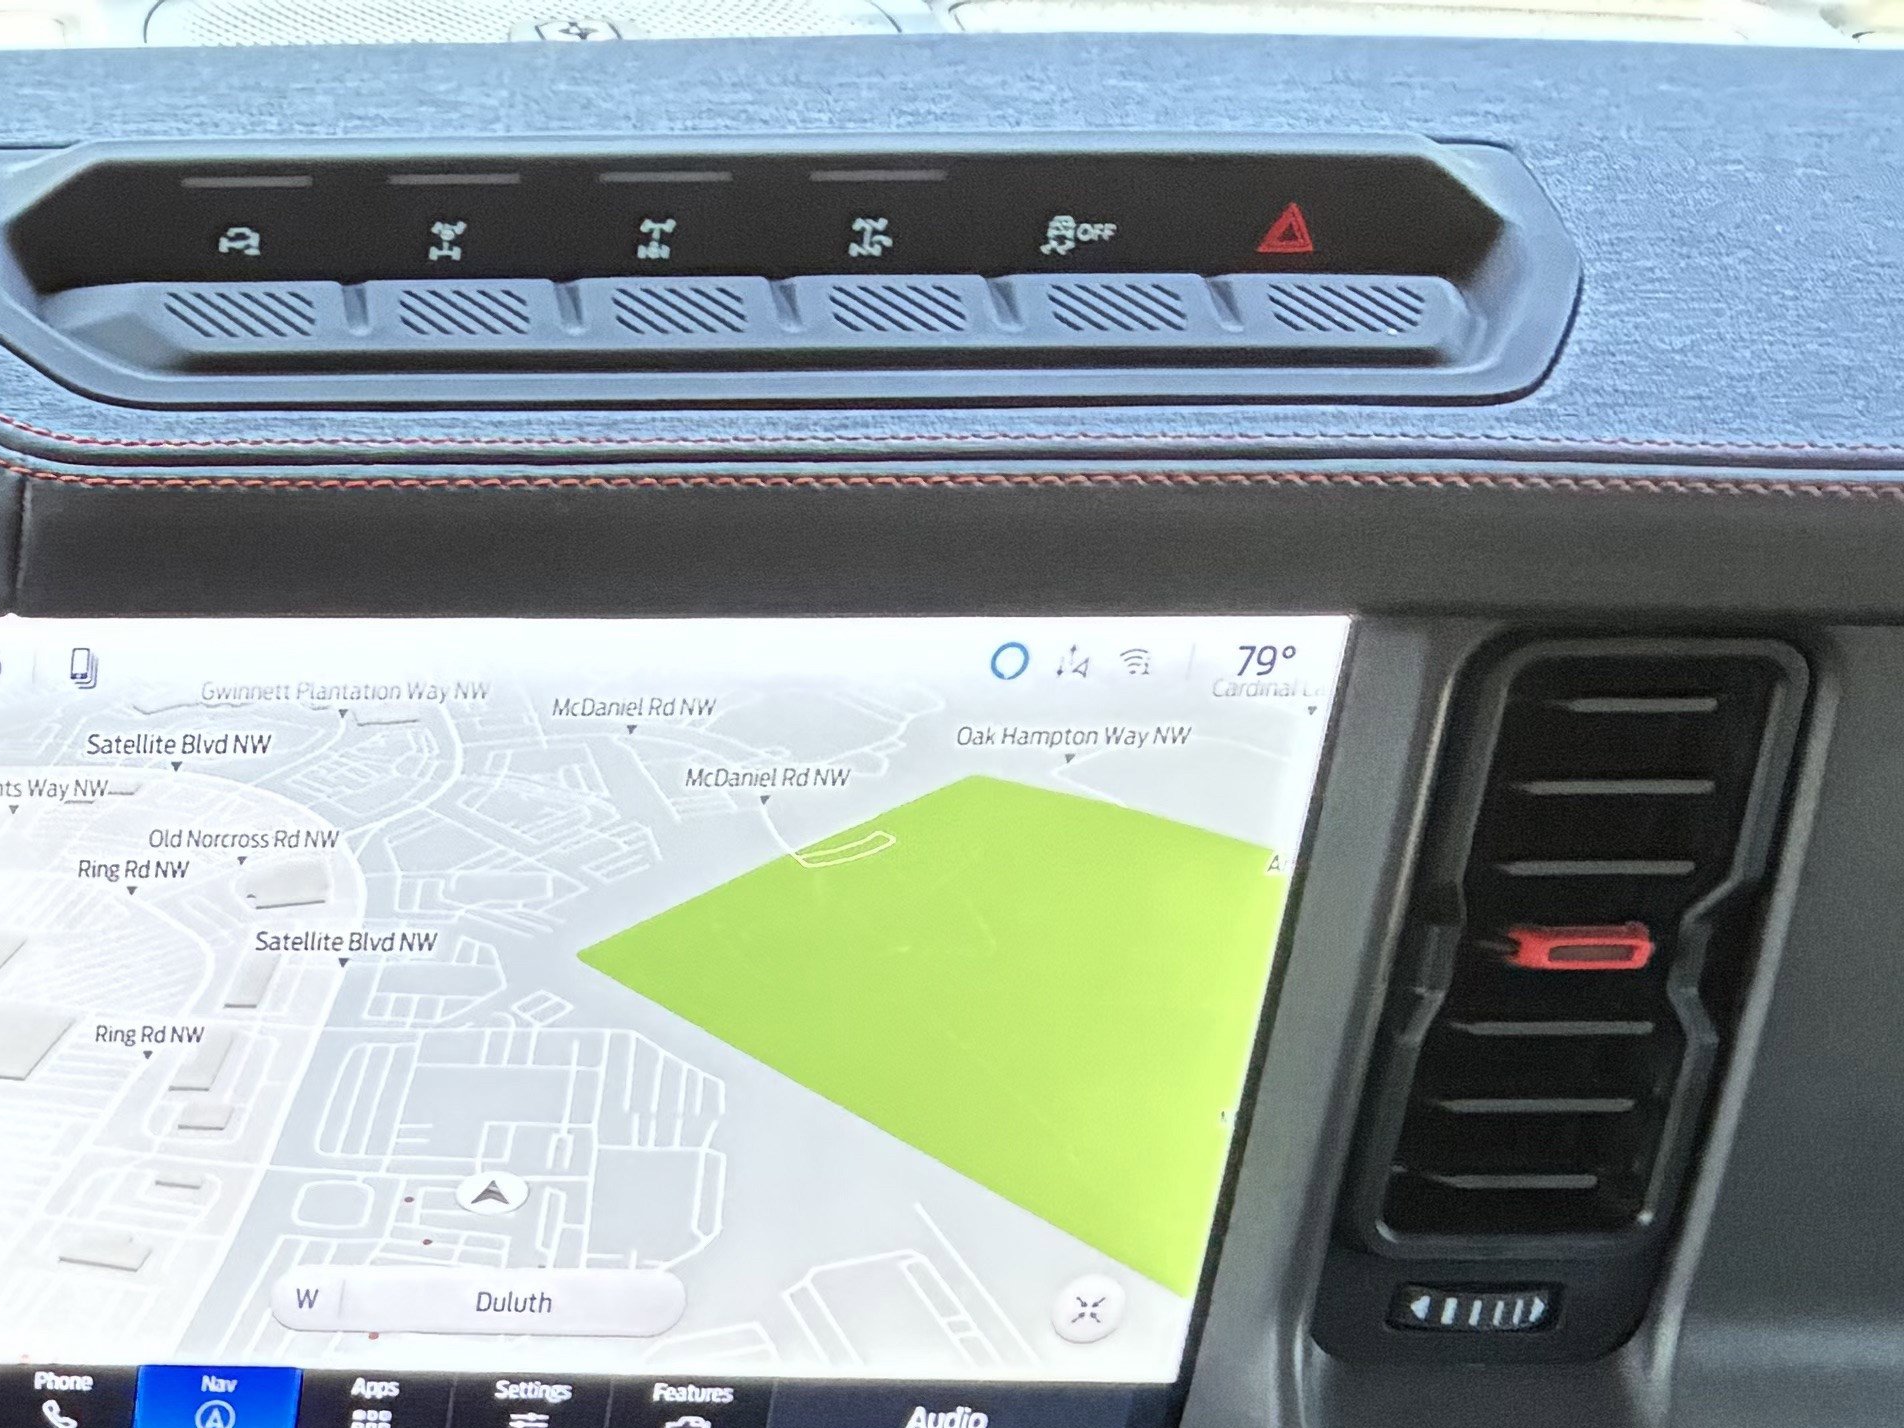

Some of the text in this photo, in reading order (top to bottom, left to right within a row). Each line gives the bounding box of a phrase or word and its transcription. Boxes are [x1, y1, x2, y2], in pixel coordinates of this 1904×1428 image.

[1077, 223, 1117, 241] OFF
[1237, 644, 1297, 677] 79°
[202, 681, 491, 704] Gwinnett Plantation Way NW
[552, 698, 716, 717] McDaniel Rd NW
[87, 734, 271, 755] Satellite Blvd NW
[957, 726, 1192, 750] Oak Hampton Way NW
[685, 768, 851, 788] McDaniel Rd NW
[28, 779, 69, 801] Way
[74, 779, 108, 797] NW
[149, 829, 339, 850] Old Norcross Rd NW
[77, 860, 190, 883] Ring Rd NW
[255, 931, 438, 952] Satellite Blvd NW
[95, 1025, 205, 1047] Ring Rd NW
[296, 1288, 553, 1315] W Duluth
[34, 1370, 93, 1391] Phone
[201, 1375, 238, 1394] Nav
[351, 1377, 400, 1399] Apps
[494, 1379, 573, 1404] Settings
[653, 1382, 734, 1404] Features
